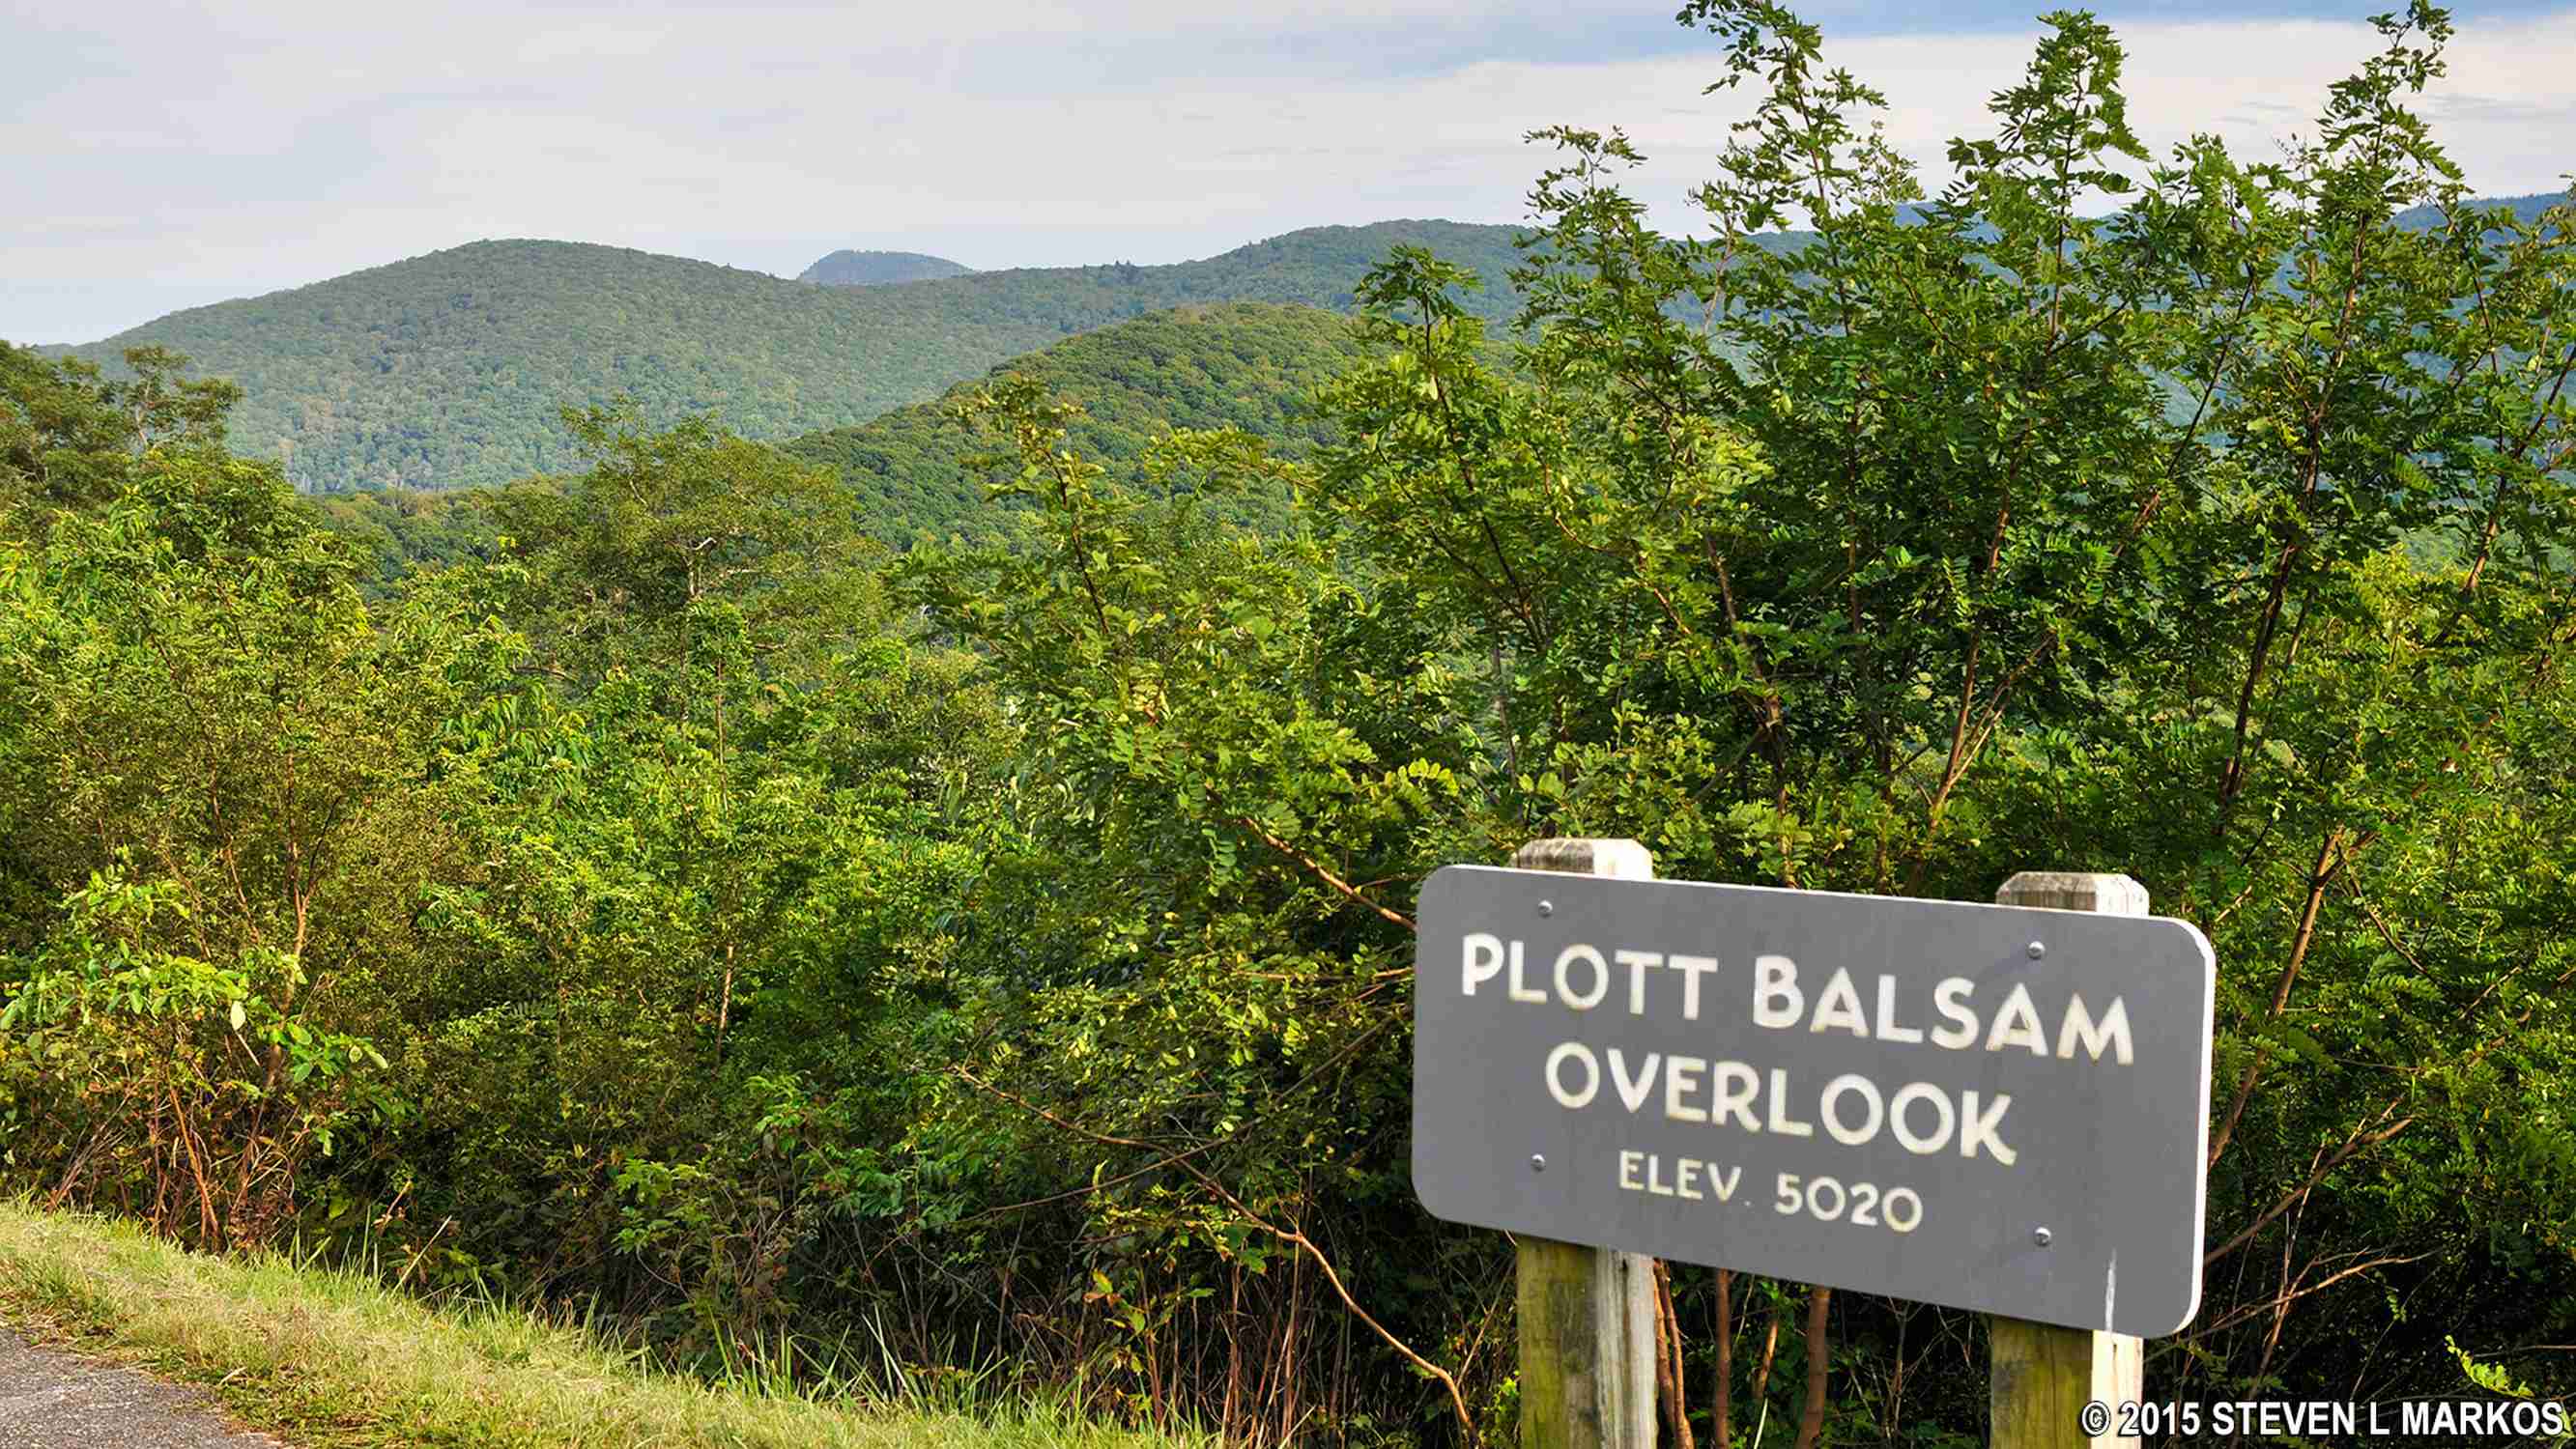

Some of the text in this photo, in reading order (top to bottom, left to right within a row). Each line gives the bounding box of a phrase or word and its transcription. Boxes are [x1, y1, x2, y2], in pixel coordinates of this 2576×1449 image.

[1462, 932, 2134, 1065] PLOTT BALSAM
[1545, 1041, 2018, 1166] OVERLOOK
[1774, 1173, 1924, 1234] 5020
